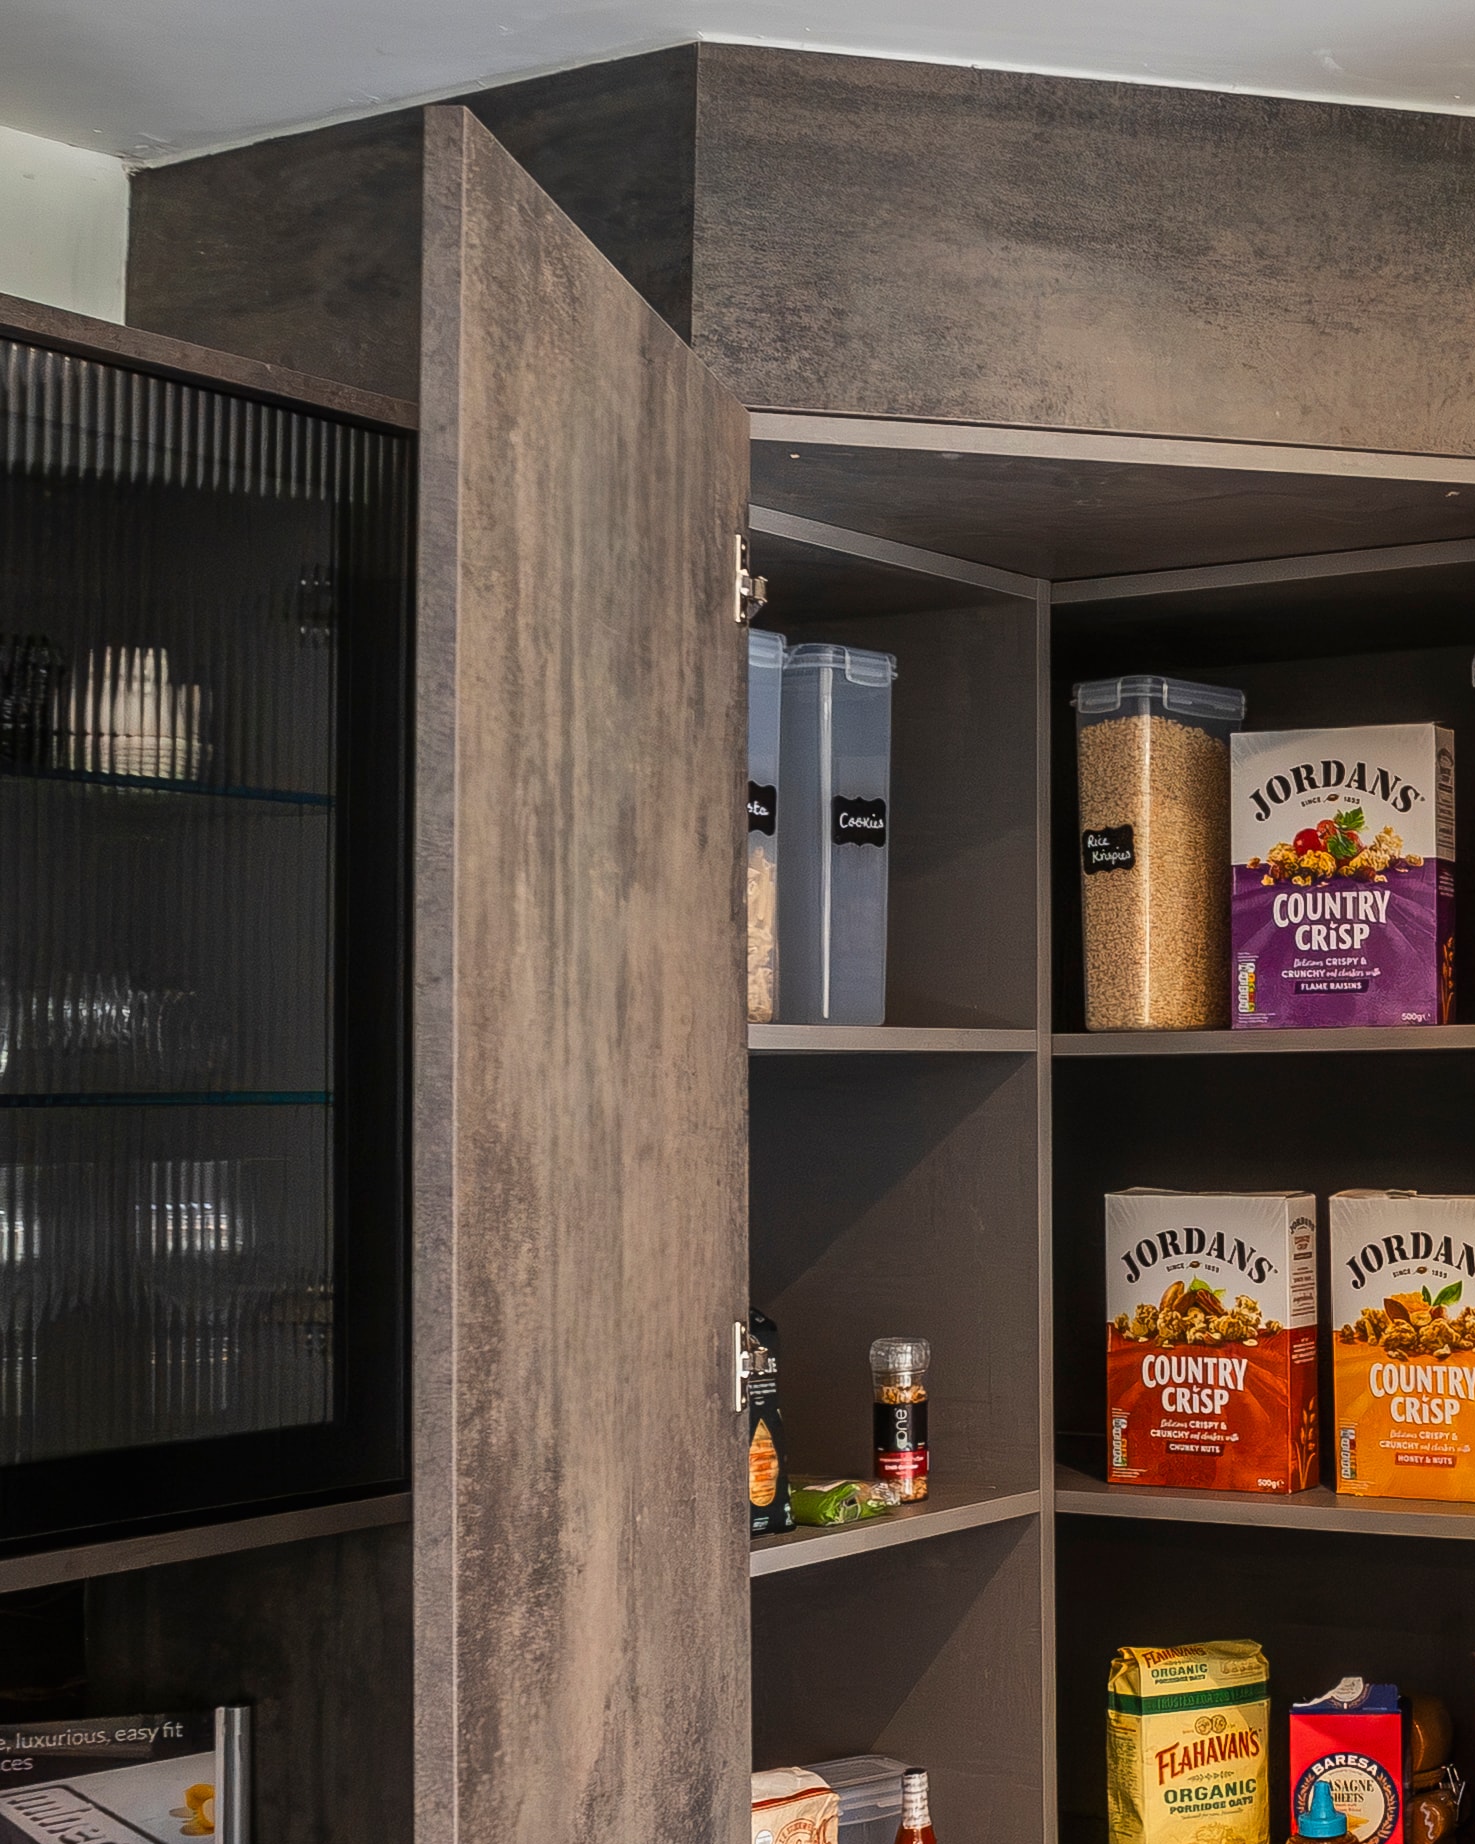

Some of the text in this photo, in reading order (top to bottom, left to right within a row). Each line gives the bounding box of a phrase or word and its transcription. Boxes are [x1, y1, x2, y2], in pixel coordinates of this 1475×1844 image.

[1249, 760, 1421, 821] JORDANS
[840, 813, 884, 828] Cookies
[1087, 834, 1110, 848] Rice
[1092, 846, 1131, 865] Krispies
[1273, 890, 1391, 928] COUNTRY
[1325, 957, 1360, 966] CRISPY
[1281, 969, 1326, 978] CRUNCHY
[1301, 982, 1362, 991] FLAME RAISINS
[1121, 1227, 1274, 1284] JORDANS
[1141, 1354, 1248, 1391] COUNTRY
[1188, 1420, 1220, 1429] CRISPY
[1150, 1429, 1189, 1439] CRUNCHY
[1418, 1431, 1451, 1441] CRISPY
[1379, 1440, 1419, 1450] CRUNCHY
[1151, 1663, 1208, 1678] ORGANIC
[16, 1729, 111, 1749] luxurious,
[115, 1726, 159, 1744] easy
[162, 1722, 184, 1738] fit
[1155, 1728, 1260, 1786] FLAHAVAN'S
[1311, 1755, 1378, 1776] BARESA
[1164, 1778, 1257, 1804] ORGANIC
[1329, 1779, 1375, 1792] ASAGNE
[1333, 1792, 1364, 1803] HEETS
[1170, 1801, 1226, 1815] PORRIDGE
[1228, 1796, 1254, 1808] OATS
